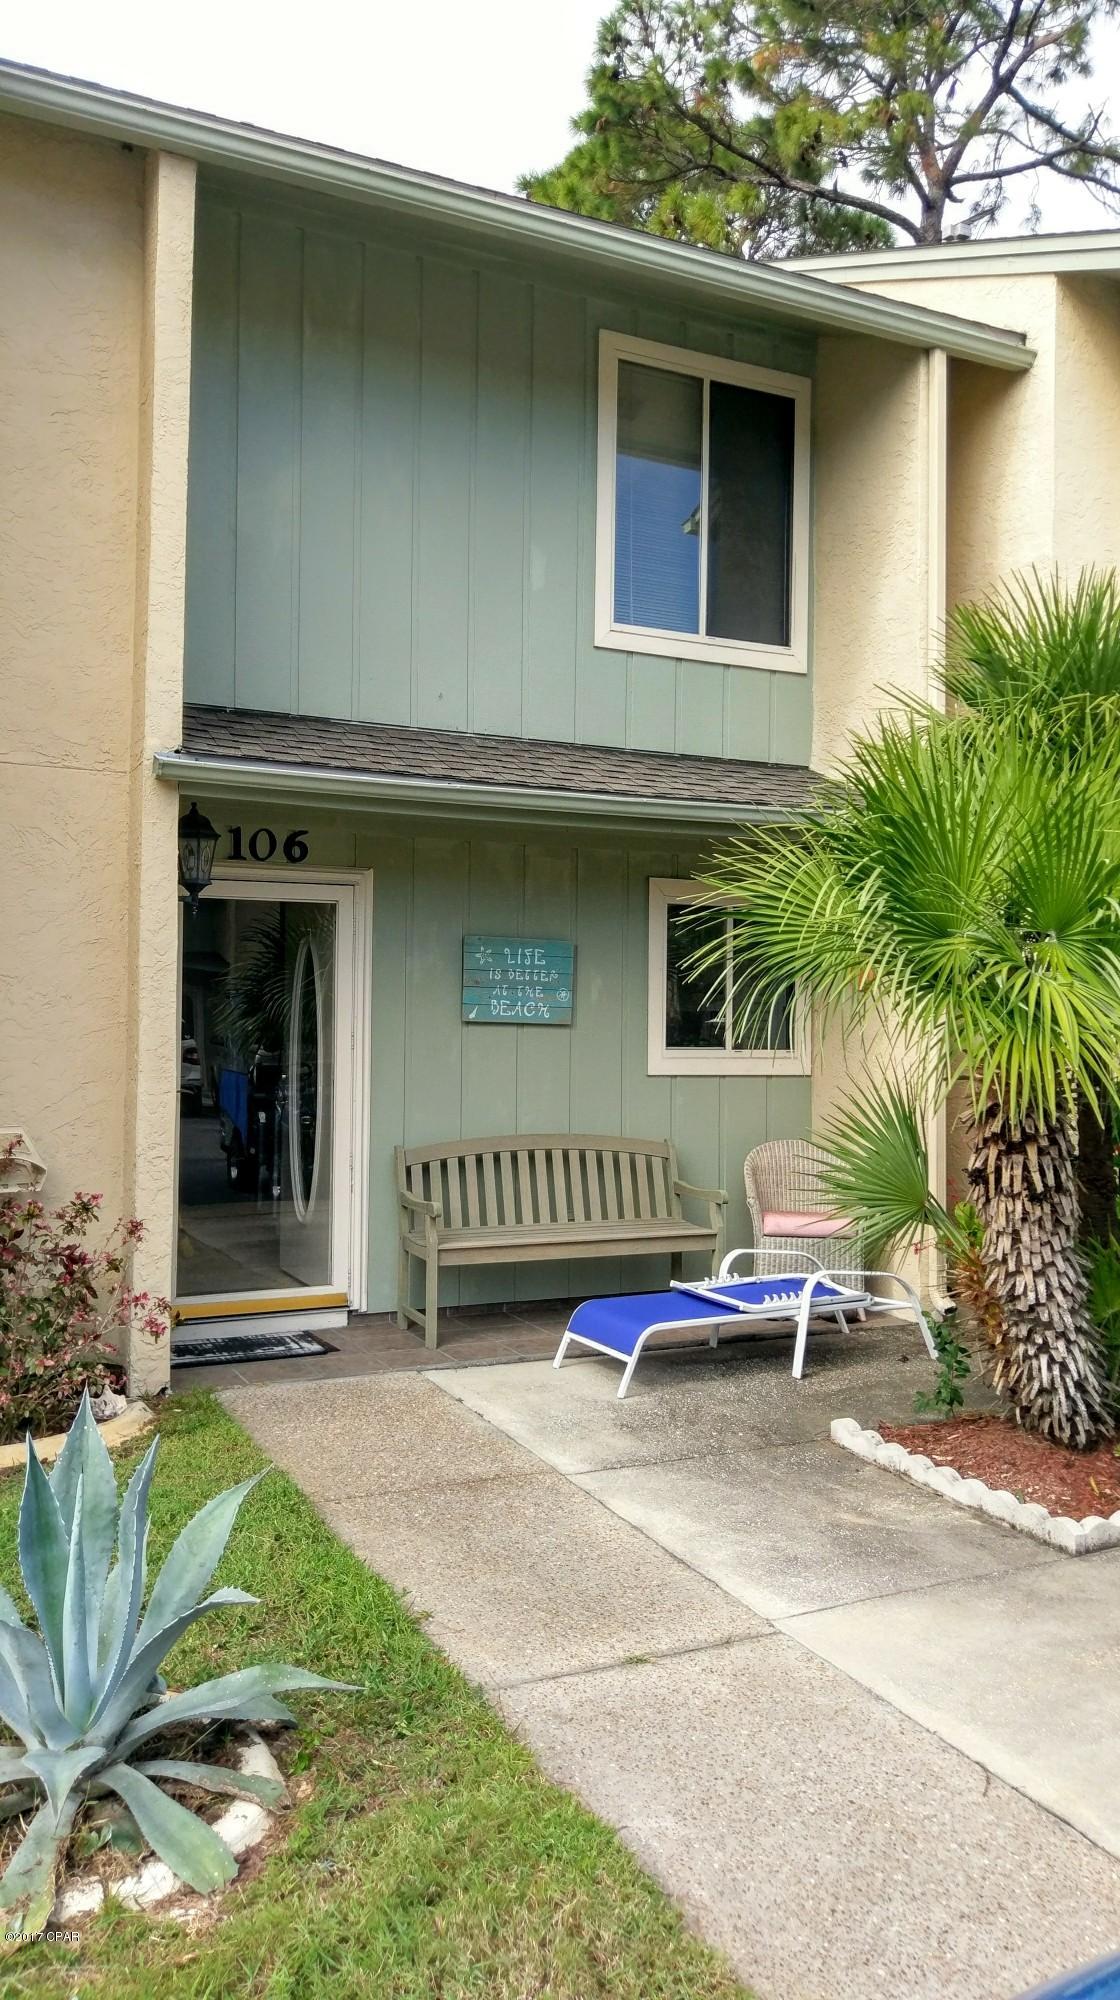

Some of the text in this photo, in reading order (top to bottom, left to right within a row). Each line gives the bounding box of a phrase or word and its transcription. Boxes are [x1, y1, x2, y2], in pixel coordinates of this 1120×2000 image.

[227, 826, 309, 863] 106
[504, 948, 546, 965] LIFE
[489, 968, 559, 982] IS BETTER
[492, 984, 544, 998] AT THE
[491, 1000, 550, 1018] BEACH
